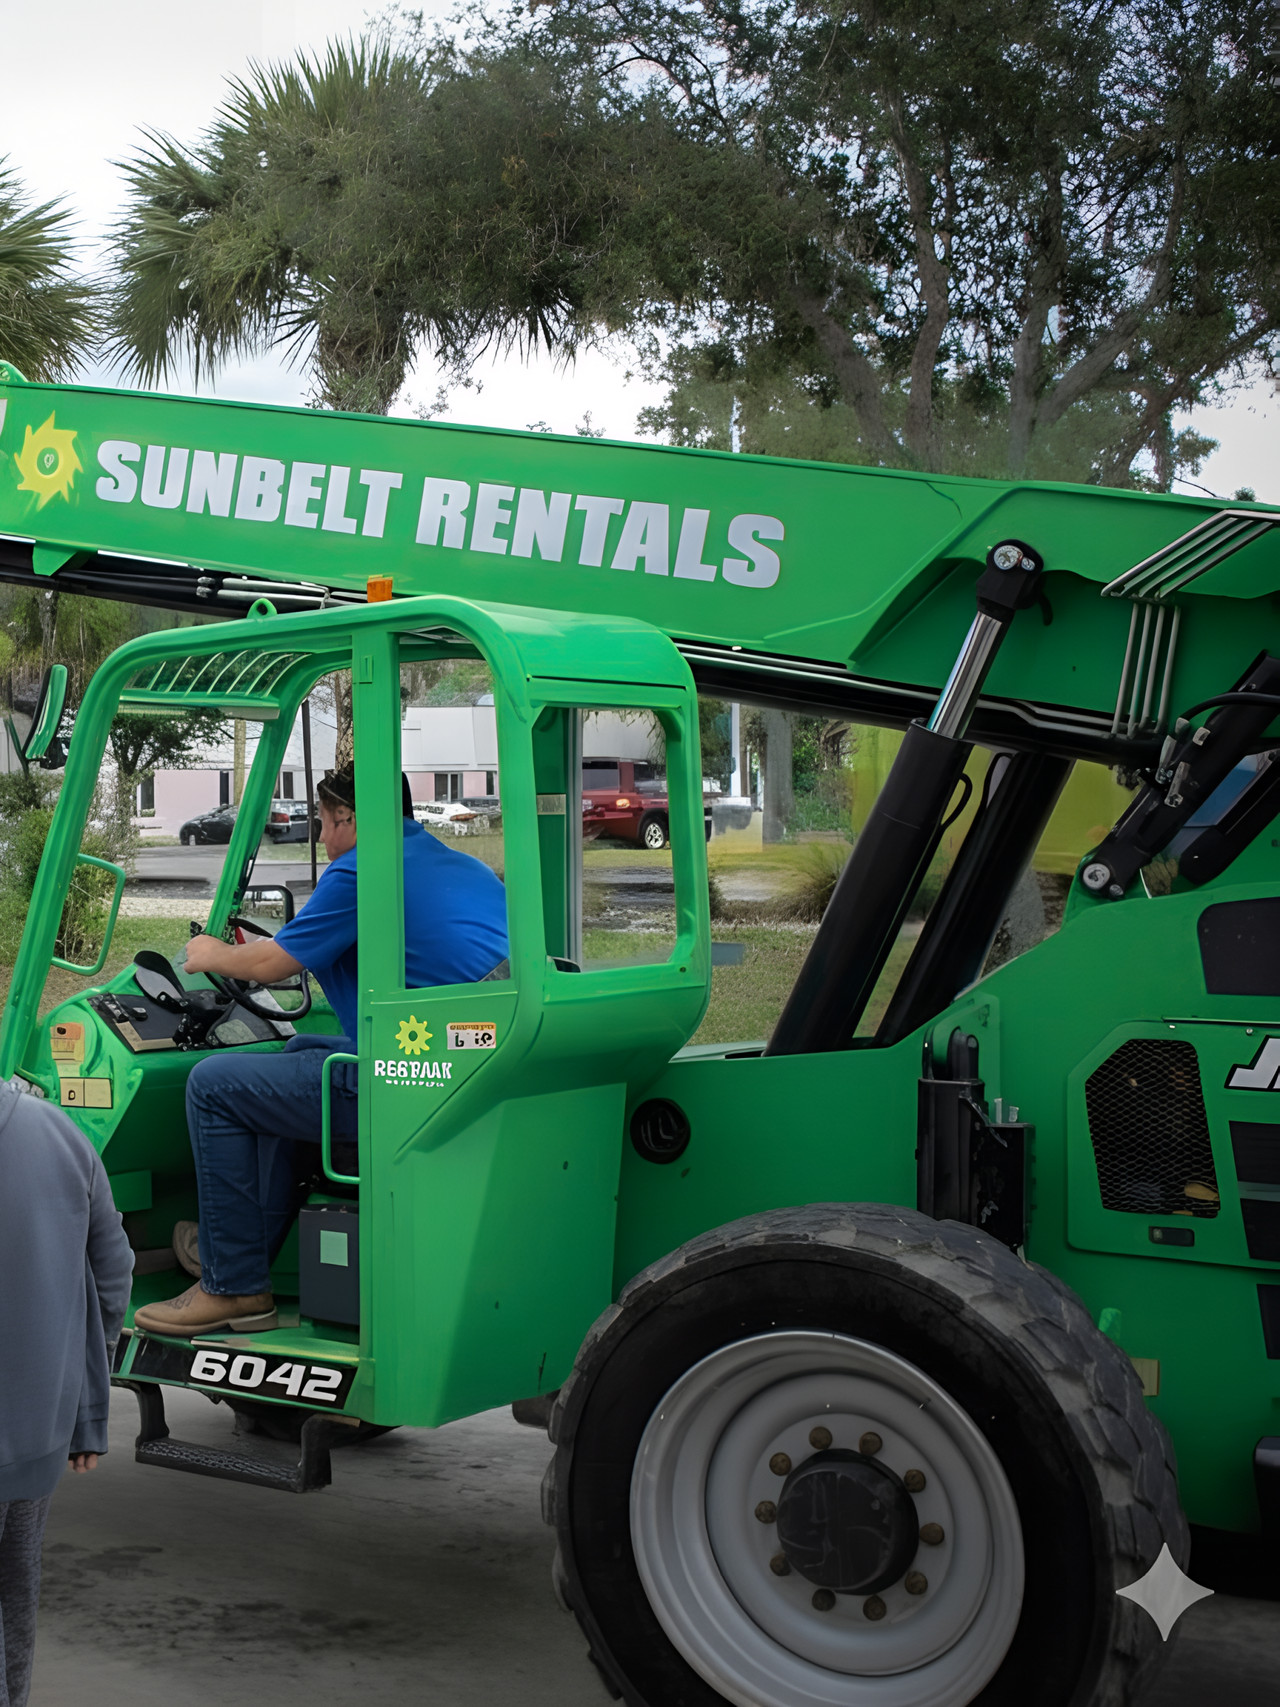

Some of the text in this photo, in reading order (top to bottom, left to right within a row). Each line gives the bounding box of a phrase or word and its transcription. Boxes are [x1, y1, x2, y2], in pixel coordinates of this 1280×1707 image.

[95, 439, 785, 588] SUNBELT RENTALS
[1225, 1035, 1280, 1092] J
[189, 1350, 344, 1402] 6042
